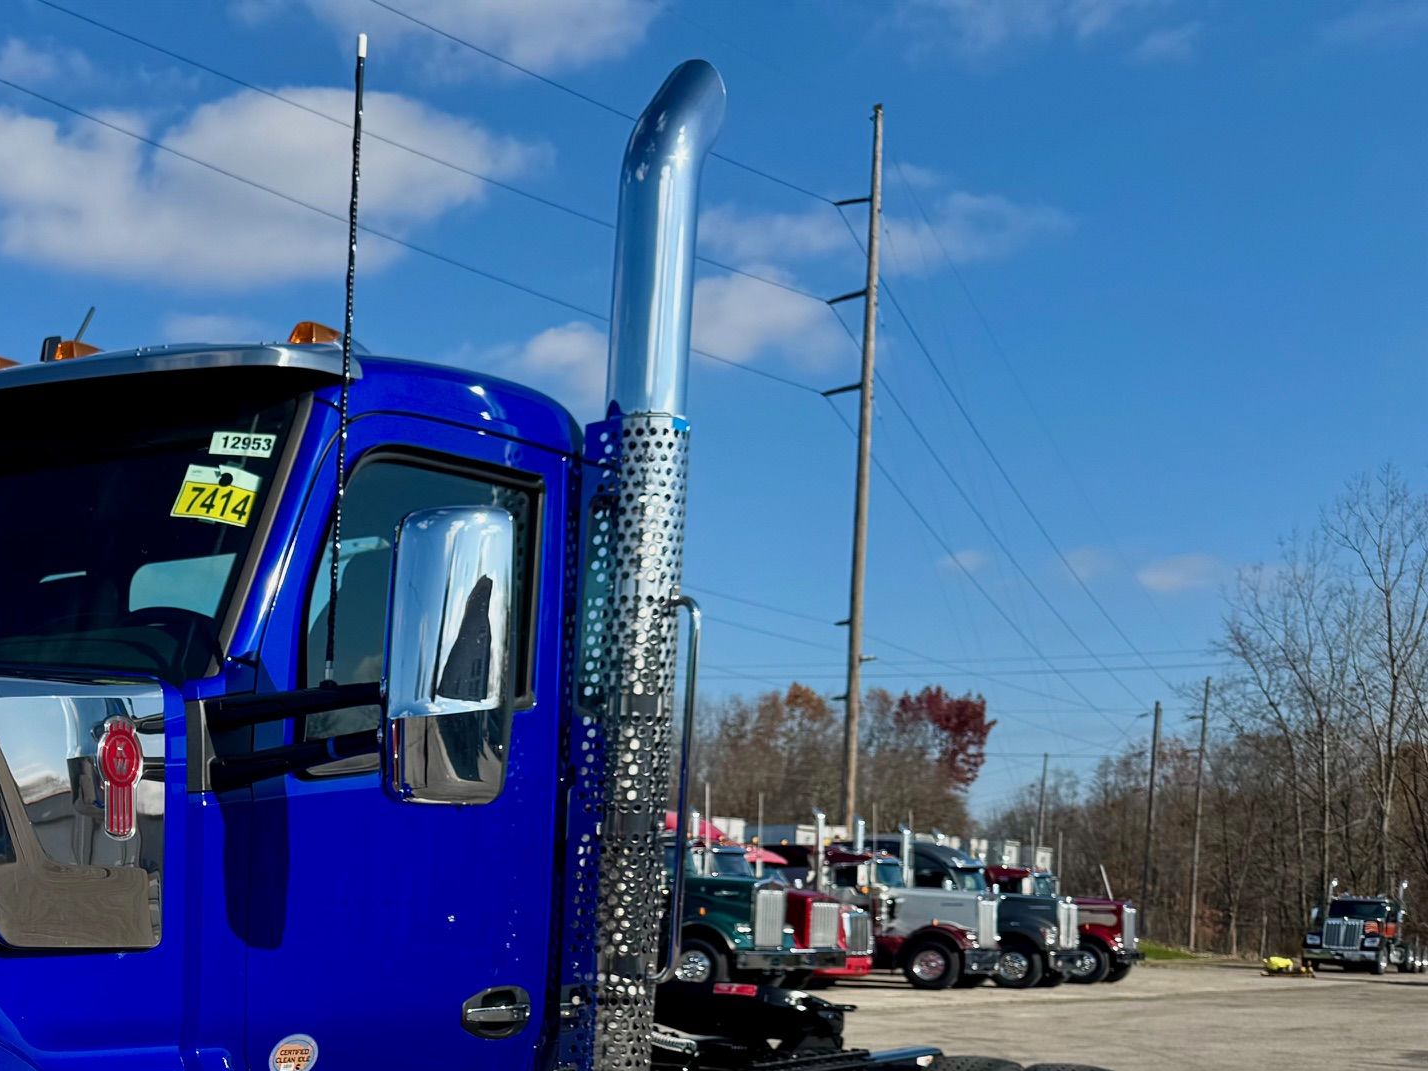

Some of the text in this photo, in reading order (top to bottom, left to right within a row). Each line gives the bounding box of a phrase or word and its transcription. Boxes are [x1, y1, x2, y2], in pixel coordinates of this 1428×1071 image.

[222, 435, 272, 452] 12953
[185, 486, 252, 521] 7414
[280, 1048, 310, 1056] CERTIFIED
[275, 1055, 311, 1064] CLEAN IDLE
